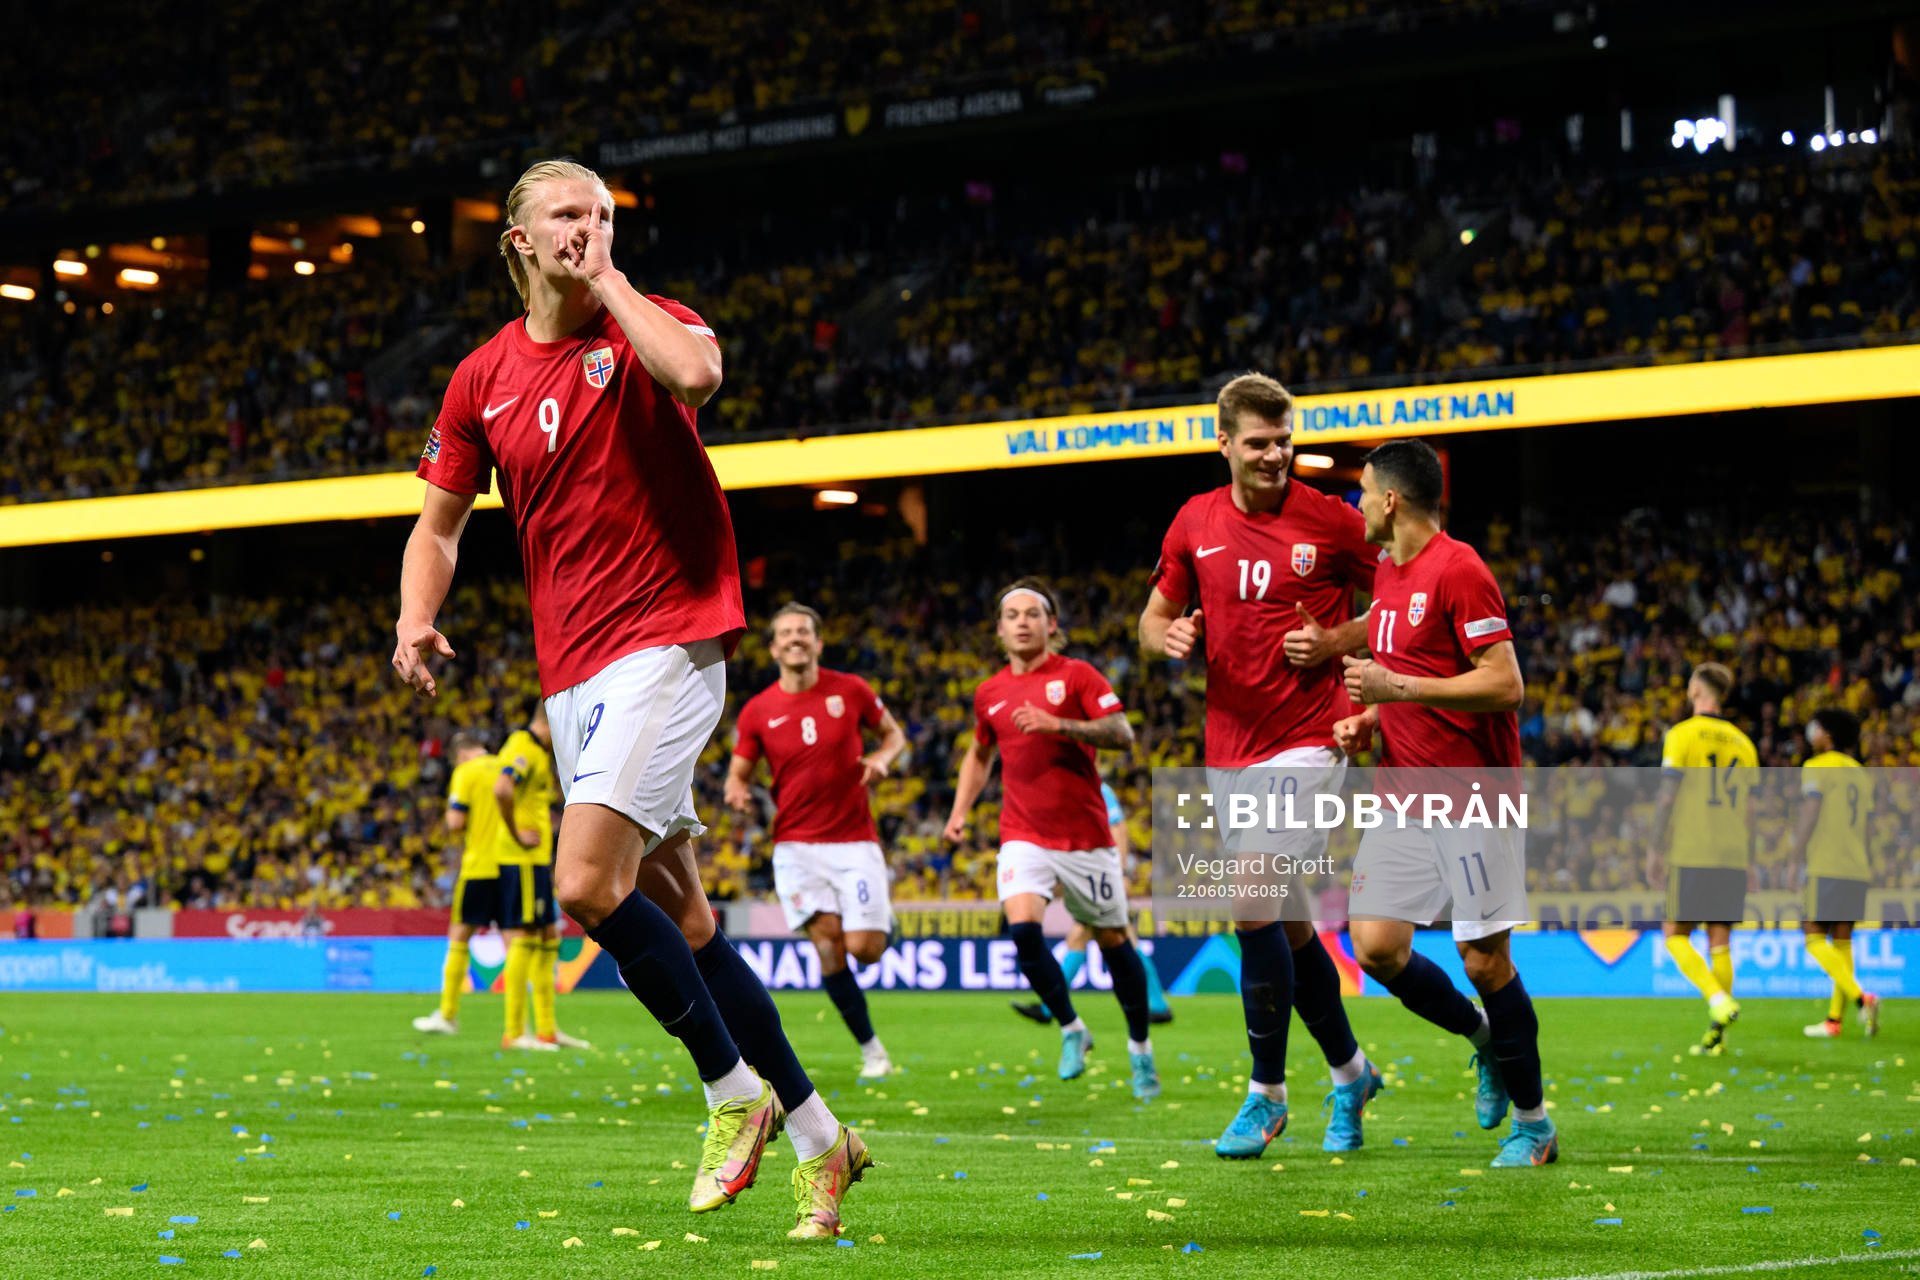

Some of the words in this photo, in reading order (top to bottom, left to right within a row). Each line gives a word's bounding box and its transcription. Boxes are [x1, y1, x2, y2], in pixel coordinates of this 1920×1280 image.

[885, 97, 959, 127] FRIENDS
[960, 90, 1022, 118] ARENA
[538, 398, 560, 453] 9
[1237, 559, 1271, 600] 19
[1376, 609, 1397, 653] 11
[582, 702, 605, 751] 9
[801, 716, 817, 745] 8
[1707, 753, 1738, 809] 14
[857, 879, 869, 904] 8
[1088, 871, 1113, 902] 16
[1459, 851, 1491, 897] 11
